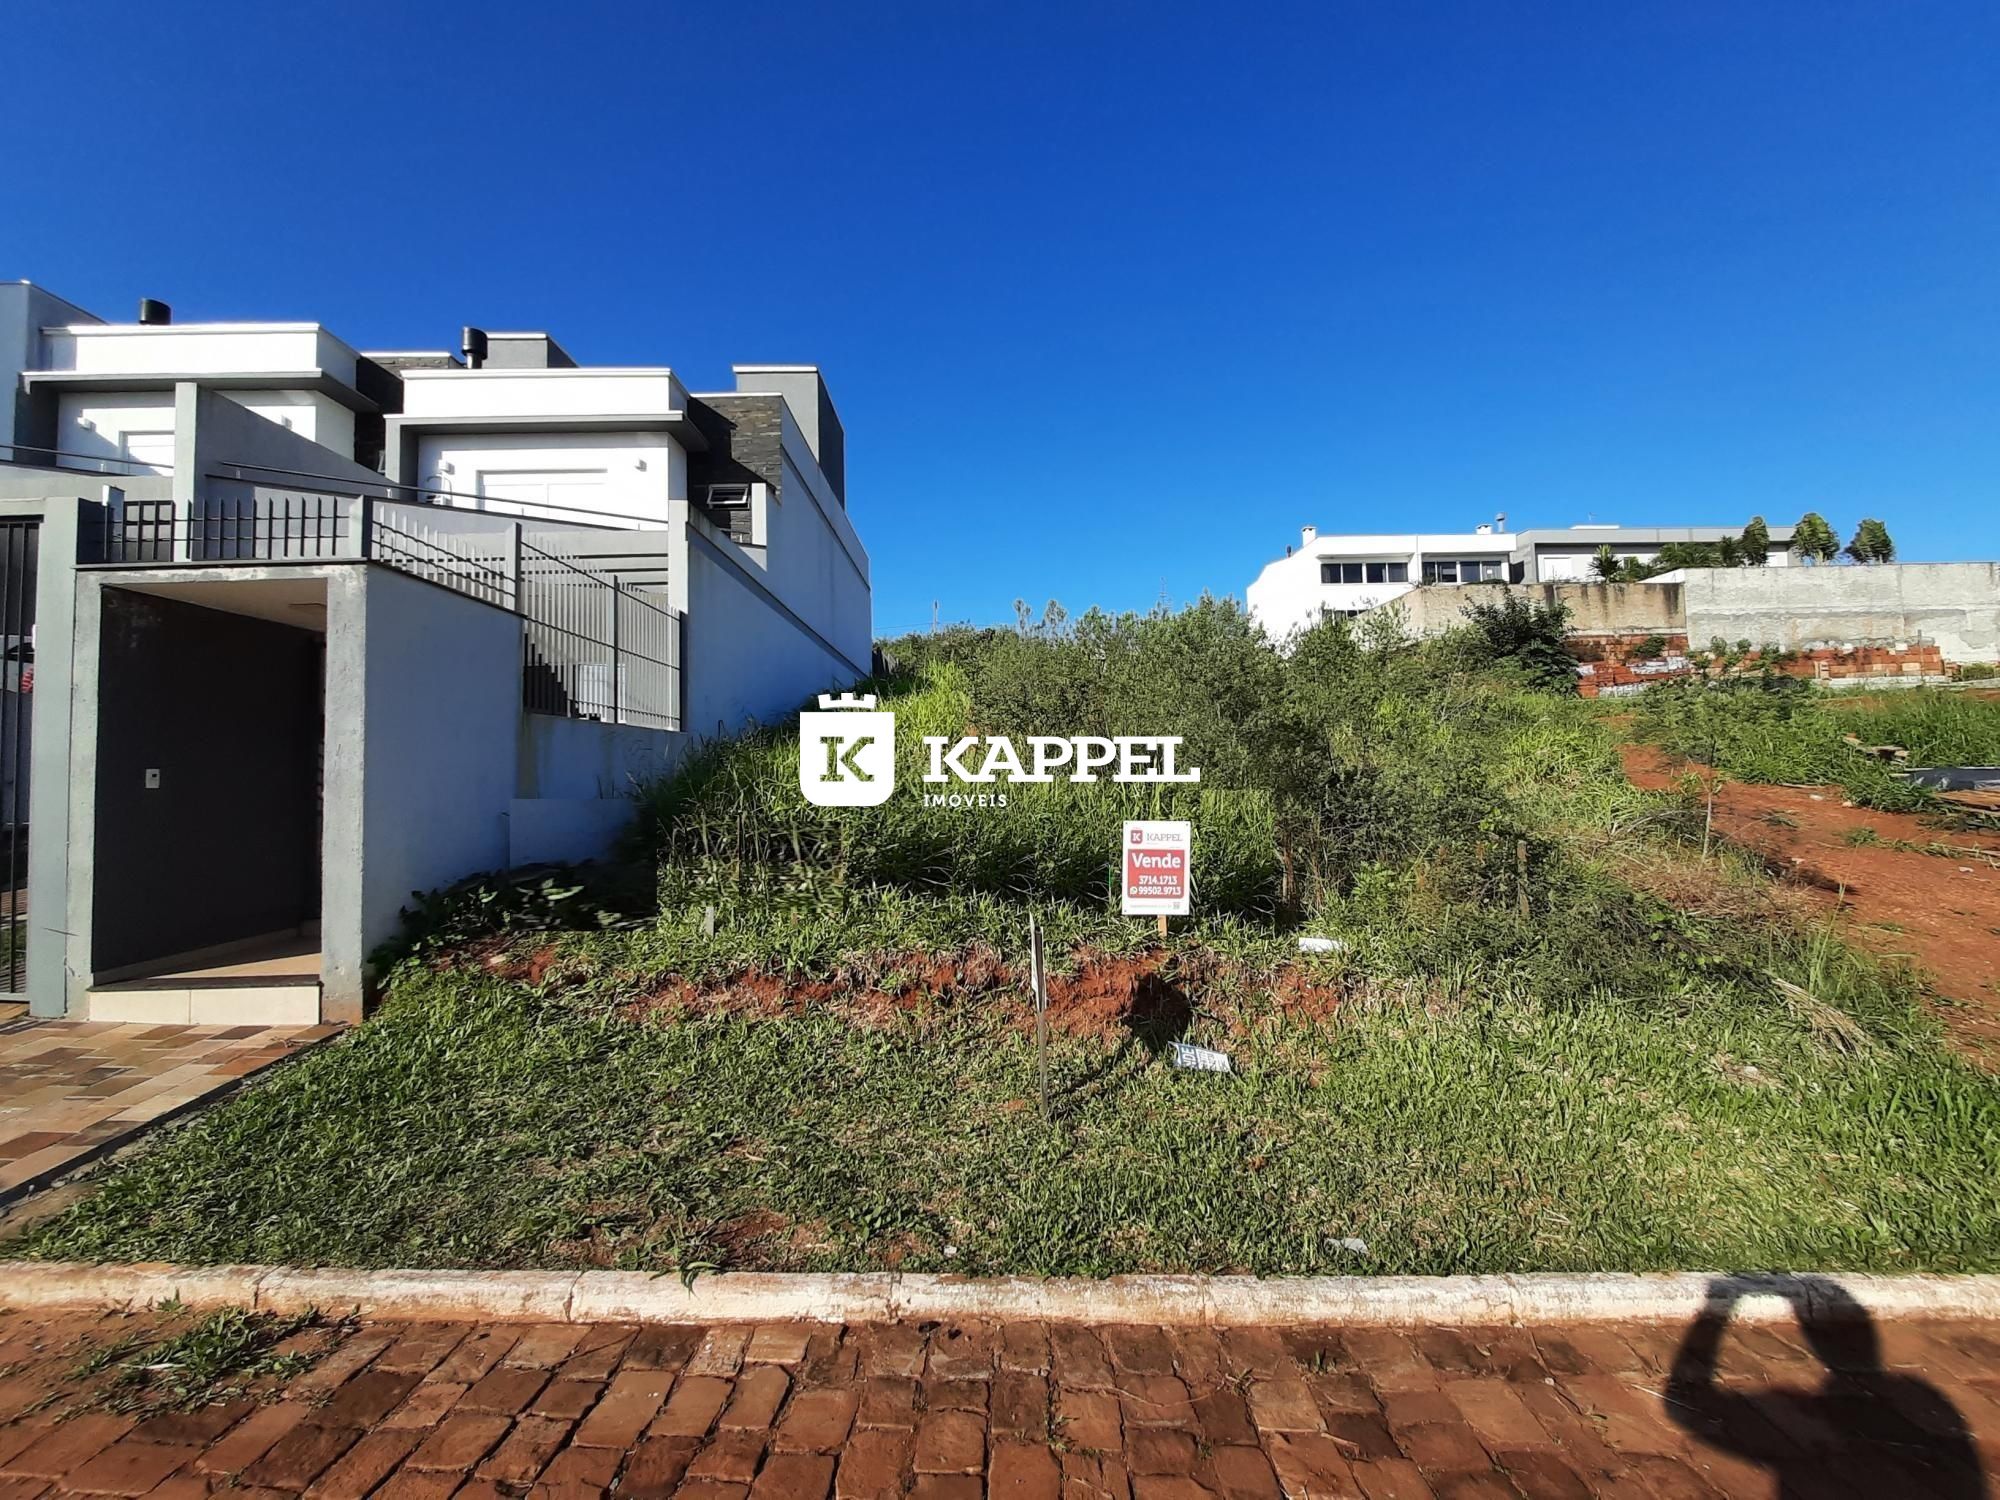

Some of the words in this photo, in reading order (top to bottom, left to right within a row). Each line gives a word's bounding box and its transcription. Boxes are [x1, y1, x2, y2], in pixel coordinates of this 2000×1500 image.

[1147, 833, 1183, 841] KAPPEL
[1132, 853, 1181, 868] Vende
[1138, 875, 1178, 885] 3714.1713
